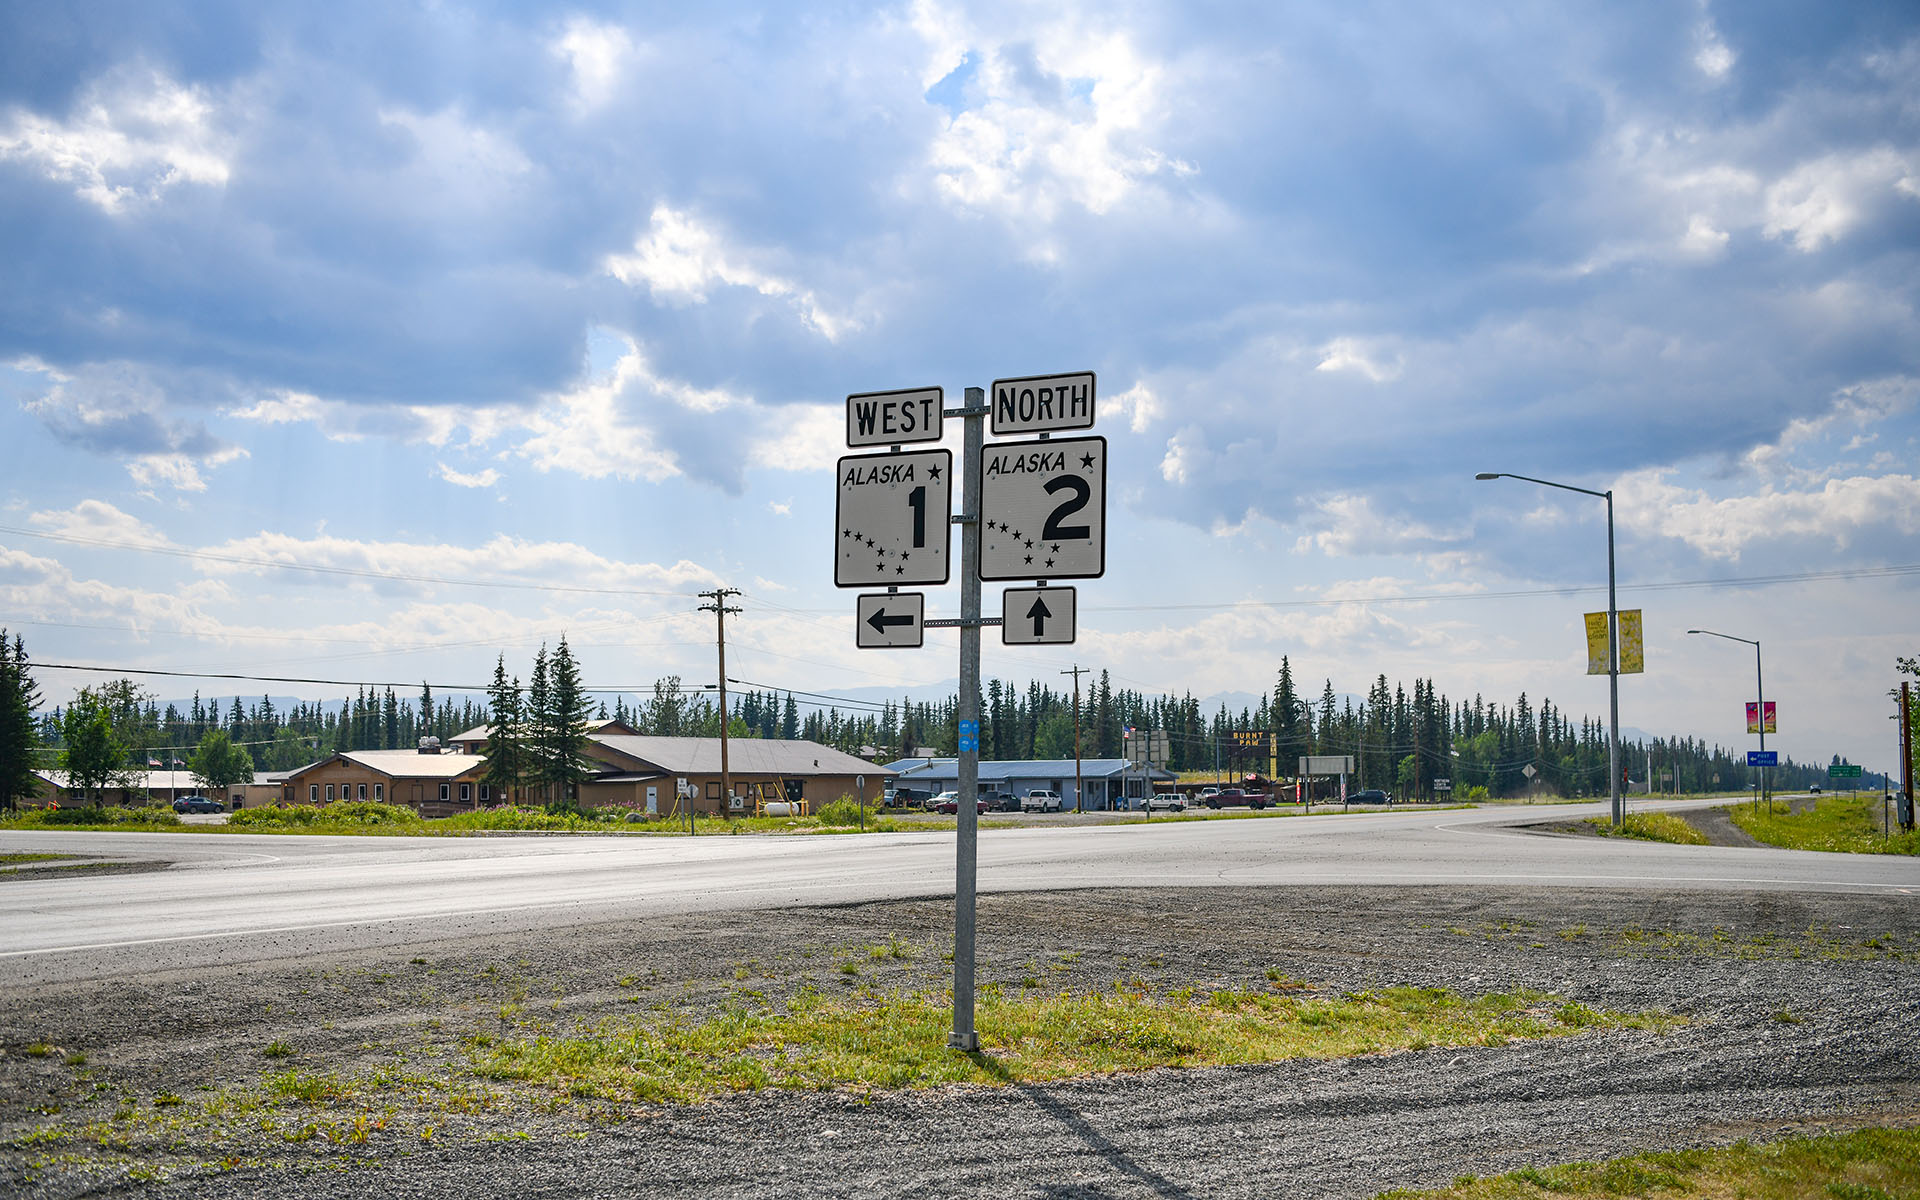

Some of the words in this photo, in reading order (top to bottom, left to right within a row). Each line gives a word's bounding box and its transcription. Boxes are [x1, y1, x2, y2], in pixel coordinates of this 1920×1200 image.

[856, 399, 934, 436] WEST
[999, 385, 1087, 423] NORTH
[843, 464, 915, 486] ALASKA
[986, 451, 1066, 476] ALASKA
[909, 485, 926, 548] 1
[1042, 474, 1091, 541] 2
